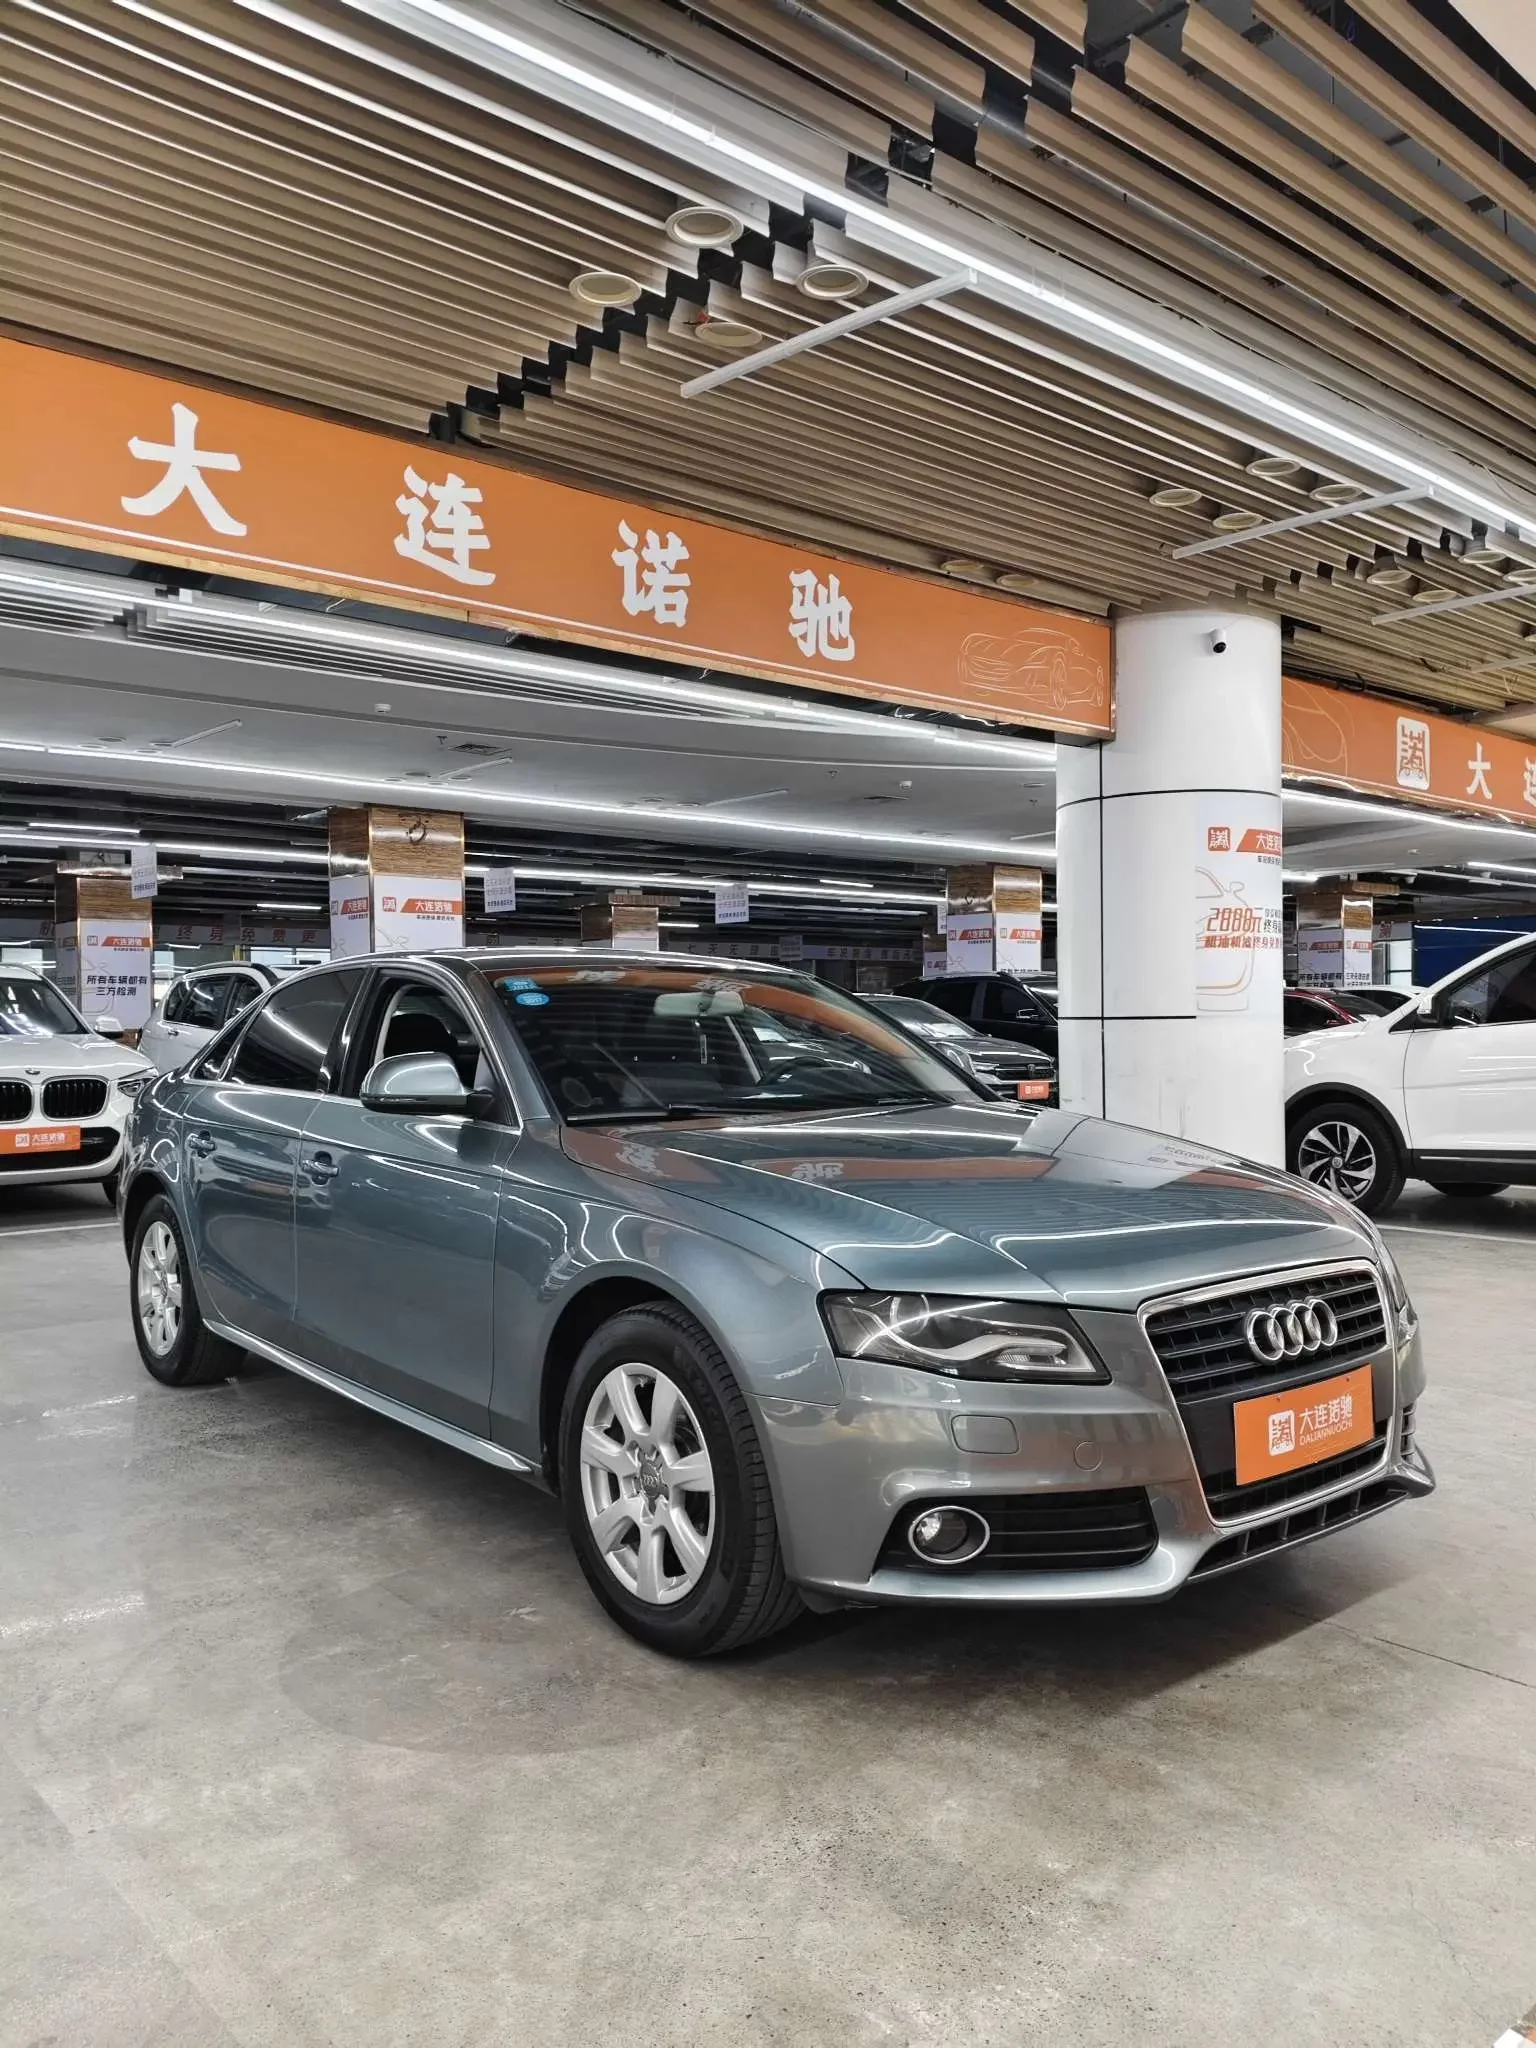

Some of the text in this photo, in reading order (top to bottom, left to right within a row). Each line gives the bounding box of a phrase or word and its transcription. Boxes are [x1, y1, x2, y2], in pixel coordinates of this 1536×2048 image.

[121, 403, 855, 662] 大连诺驰
[86, 975, 148, 985] 所有车辆都有
[96, 986, 137, 996] 三方检测
[1299, 1394, 1353, 1434] 大连诺驰
